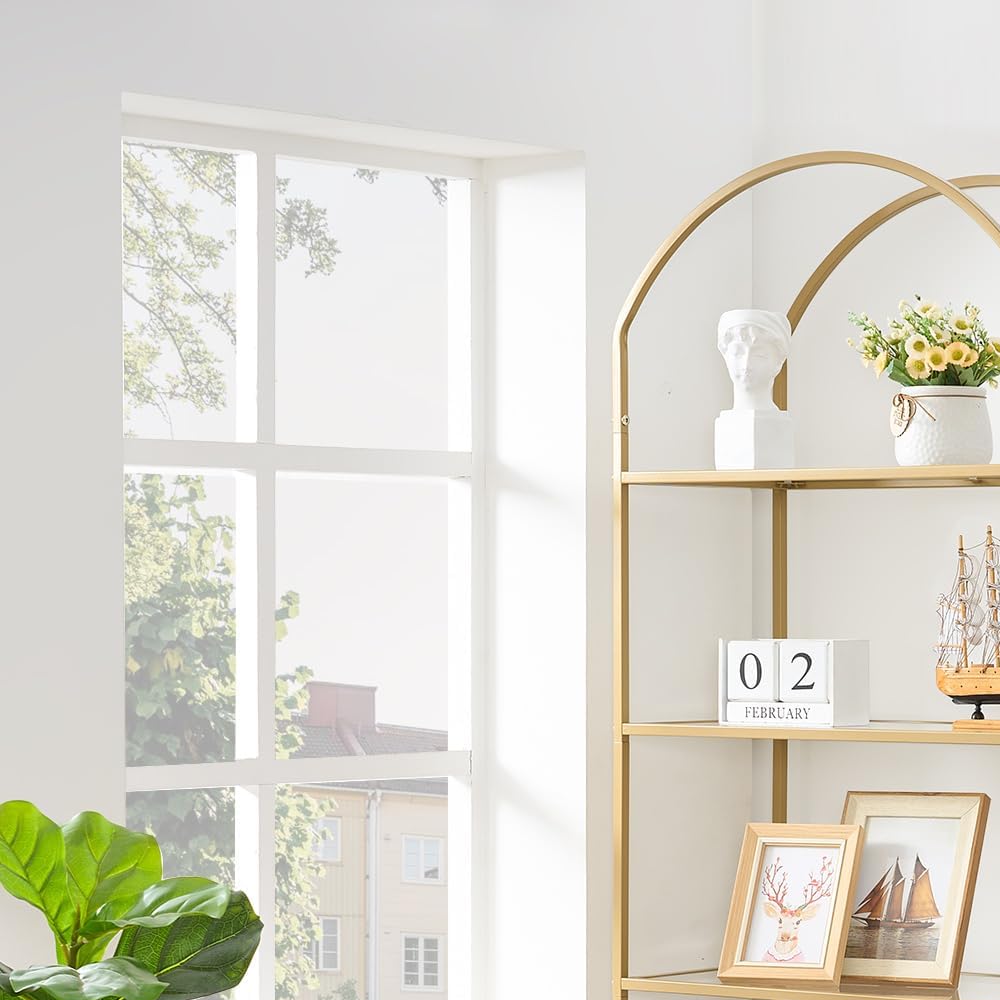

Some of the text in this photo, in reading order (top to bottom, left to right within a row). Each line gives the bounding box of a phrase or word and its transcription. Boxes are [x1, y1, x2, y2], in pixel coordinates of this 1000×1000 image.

[739, 652, 816, 690] 0 2
[745, 706, 811, 720] FEBRUARY
